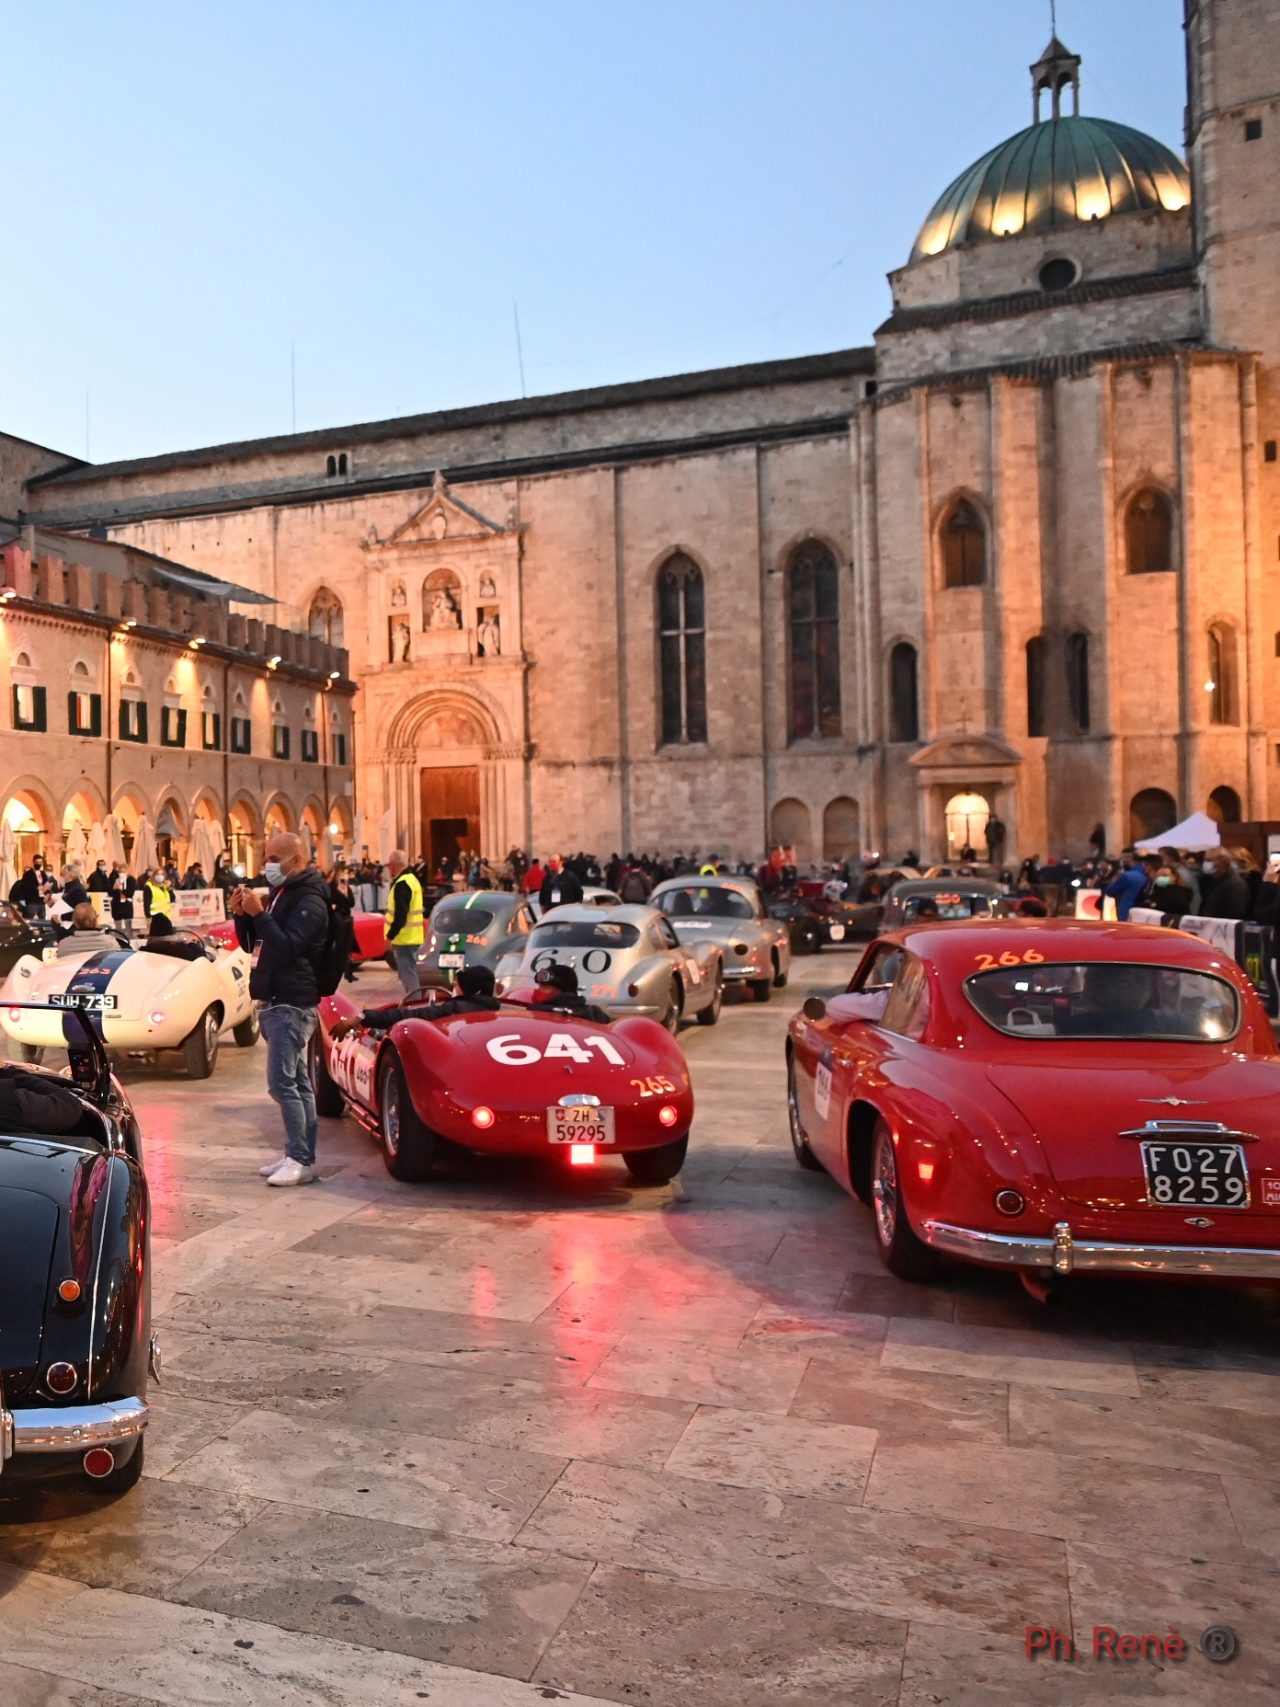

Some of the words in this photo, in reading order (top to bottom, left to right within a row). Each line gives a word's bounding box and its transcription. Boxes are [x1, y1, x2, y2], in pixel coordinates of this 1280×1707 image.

[974, 948, 1045, 971] 266
[77, 967, 112, 975] 263
[85, 994, 115, 1009] 739
[486, 1033, 626, 1066] 641
[630, 1074, 677, 1097] 265
[573, 1112, 590, 1123] ZH
[556, 1124, 606, 1142] 59295
[1154, 1175, 1244, 1204] 8259
